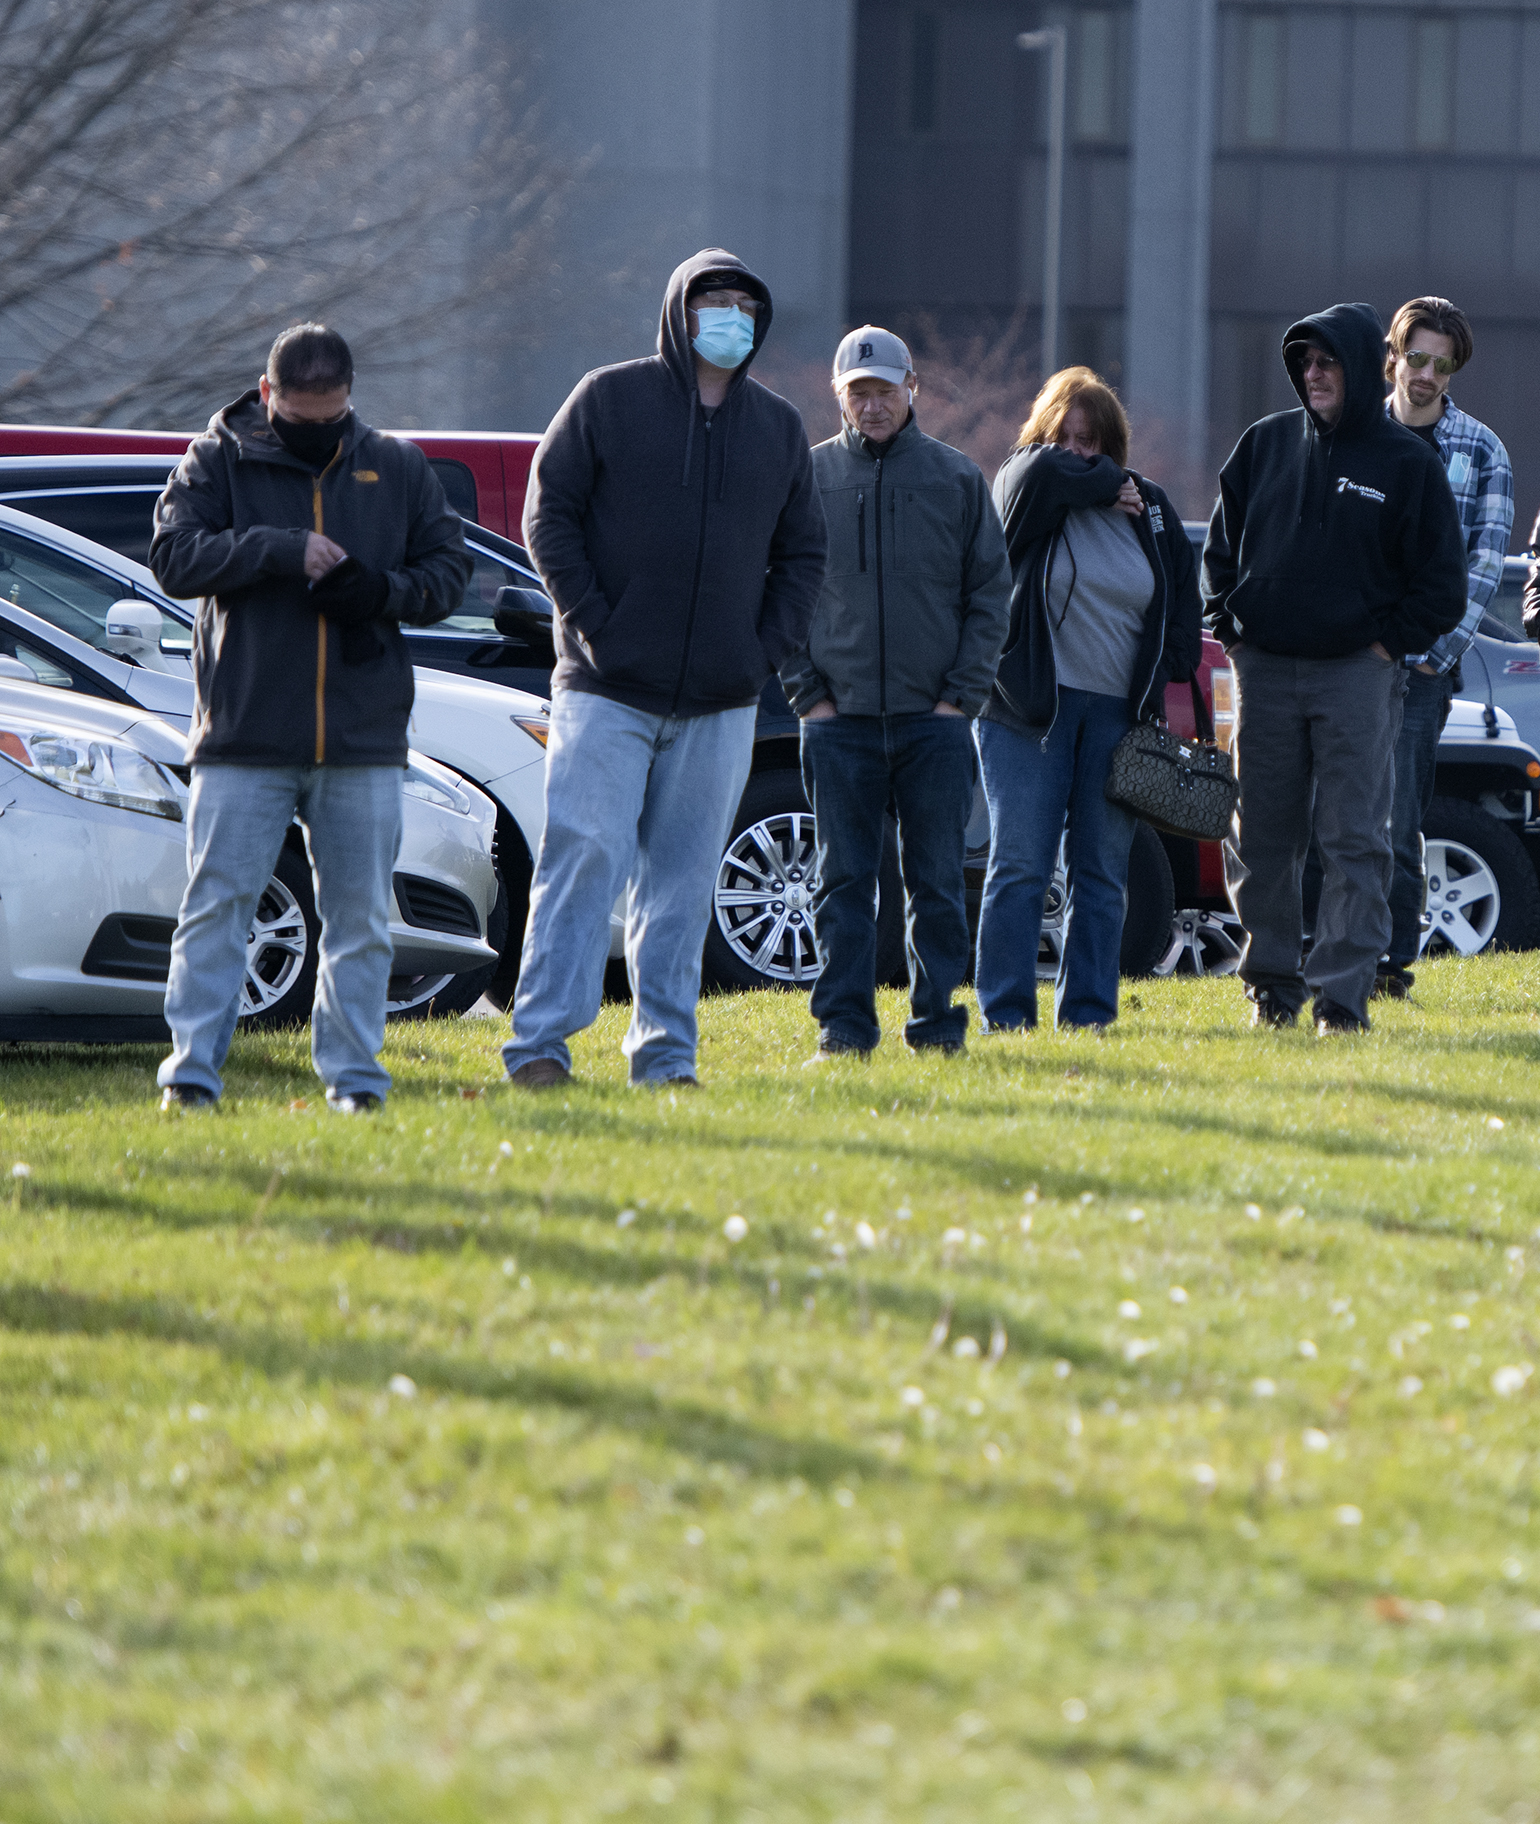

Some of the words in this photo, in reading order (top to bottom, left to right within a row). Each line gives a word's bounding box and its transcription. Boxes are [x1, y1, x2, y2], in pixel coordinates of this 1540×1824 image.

[858, 342, 874, 361] D
[1337, 477, 1349, 492] 7
[1347, 481, 1386, 498] Seasons
